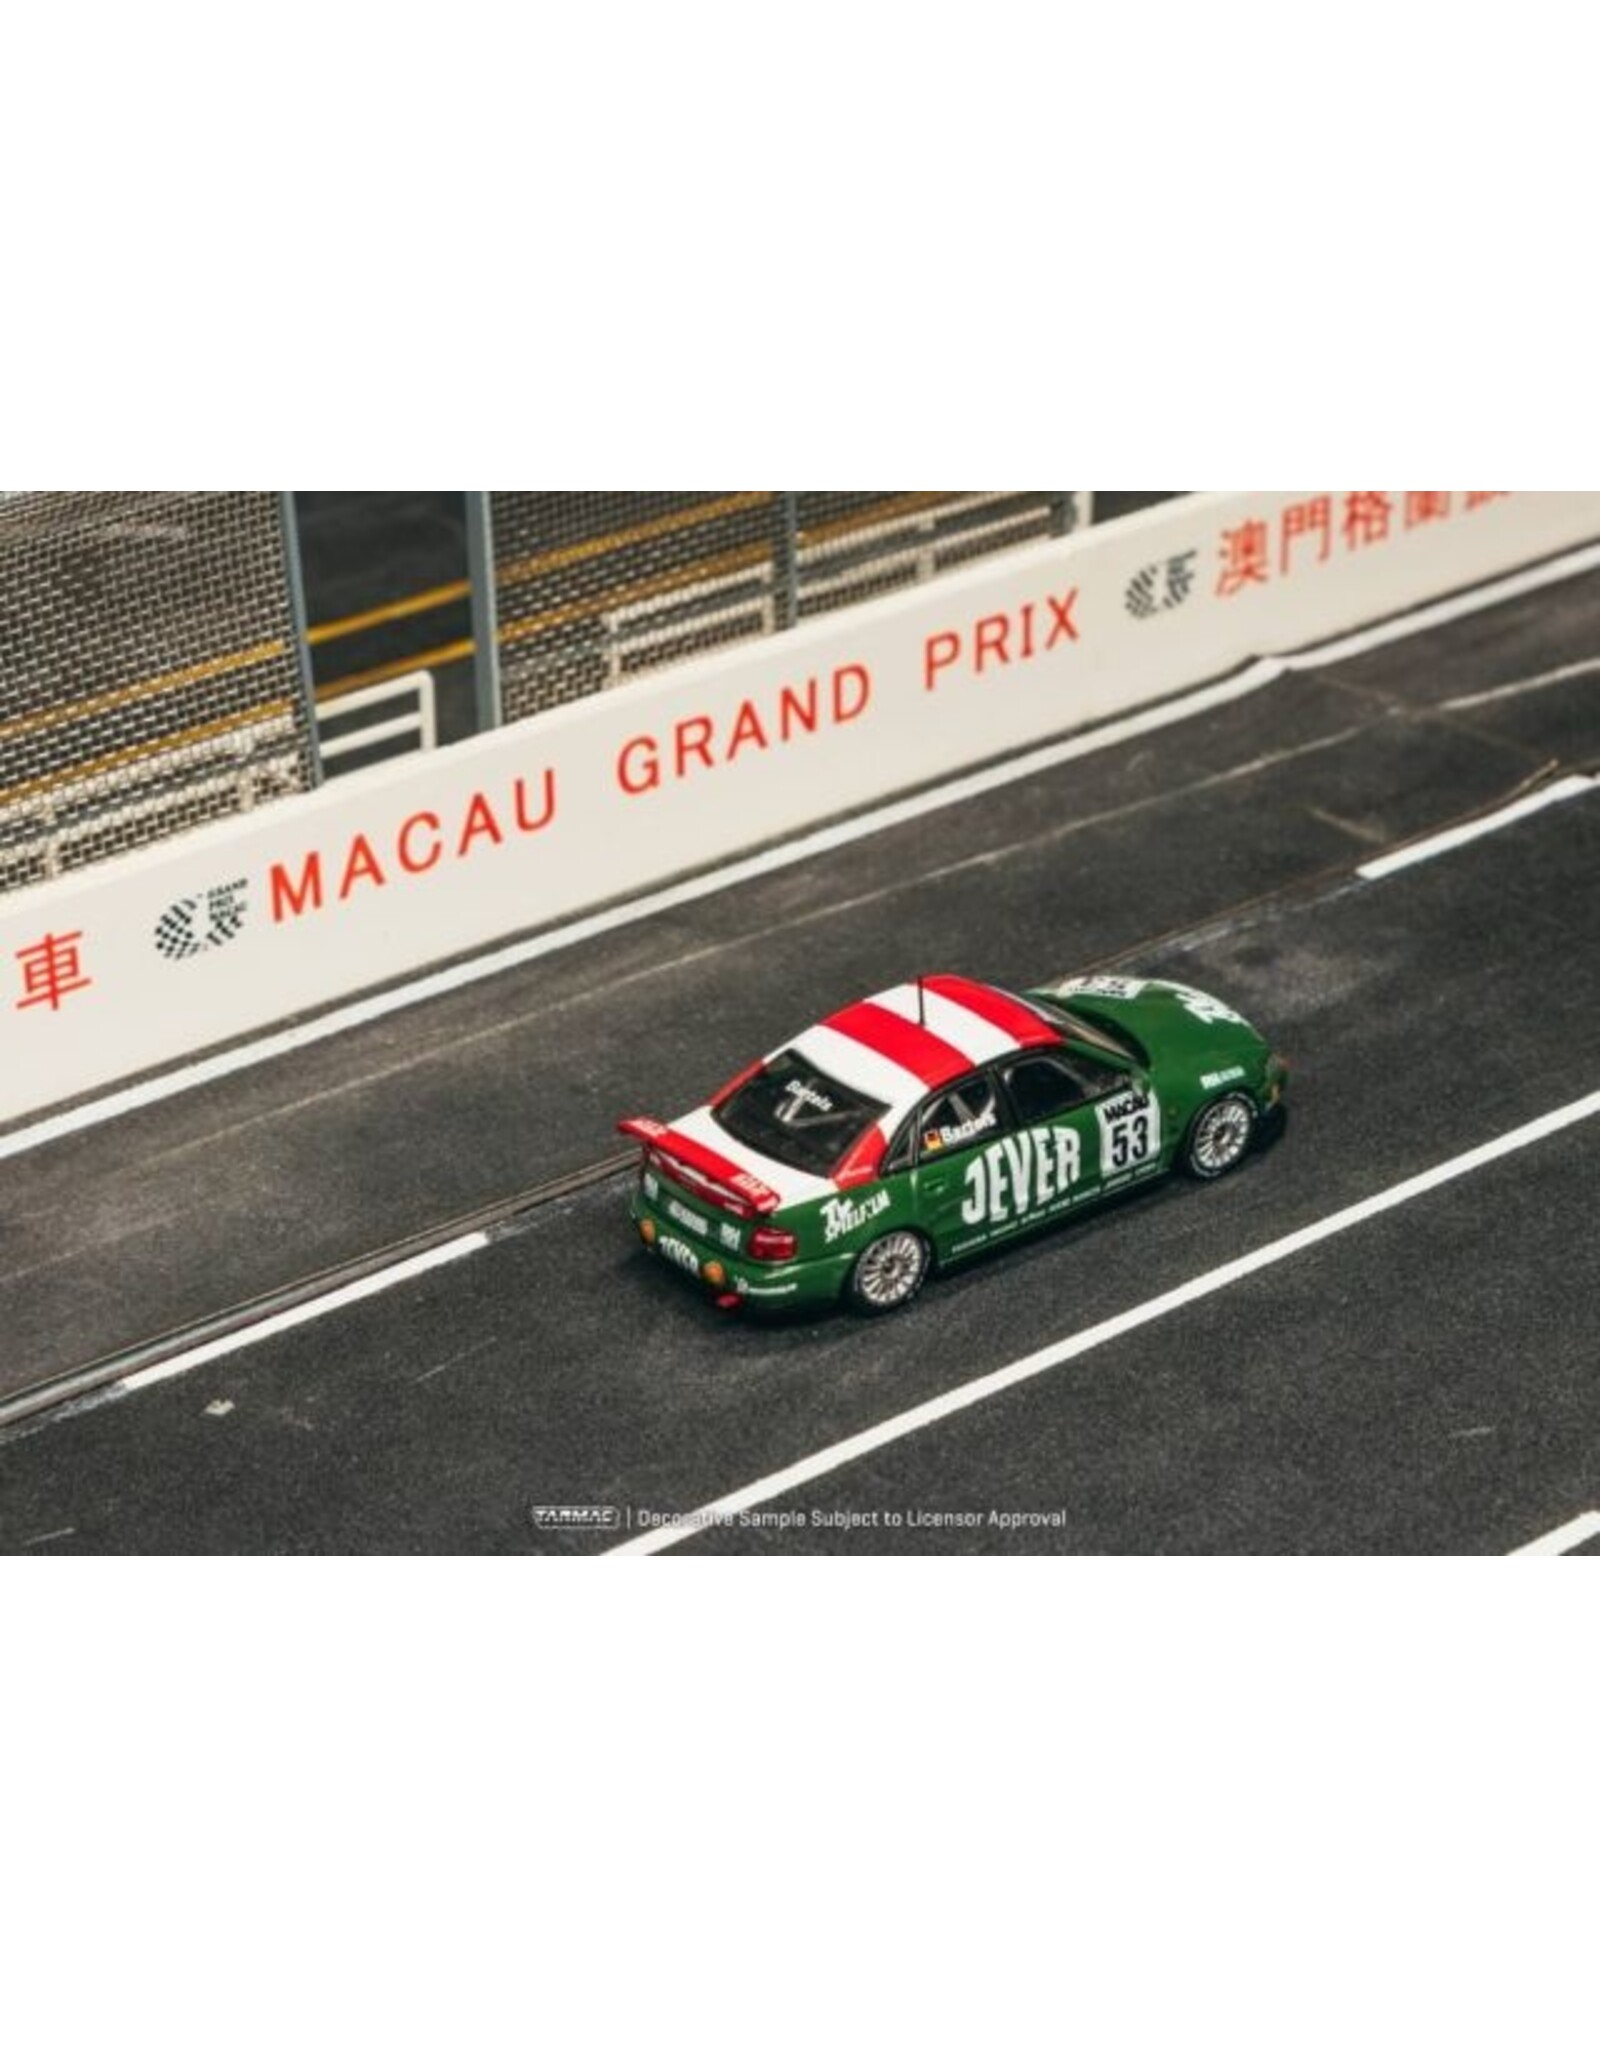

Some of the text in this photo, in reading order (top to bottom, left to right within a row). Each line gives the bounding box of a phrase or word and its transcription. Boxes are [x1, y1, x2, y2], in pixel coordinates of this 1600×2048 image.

[267, 588, 1079, 922] MACAU GRAND PRIX
[15, 930, 92, 1011] 車
[961, 1126, 1081, 1225] JEVER
[1112, 1115, 1148, 1167] 53
